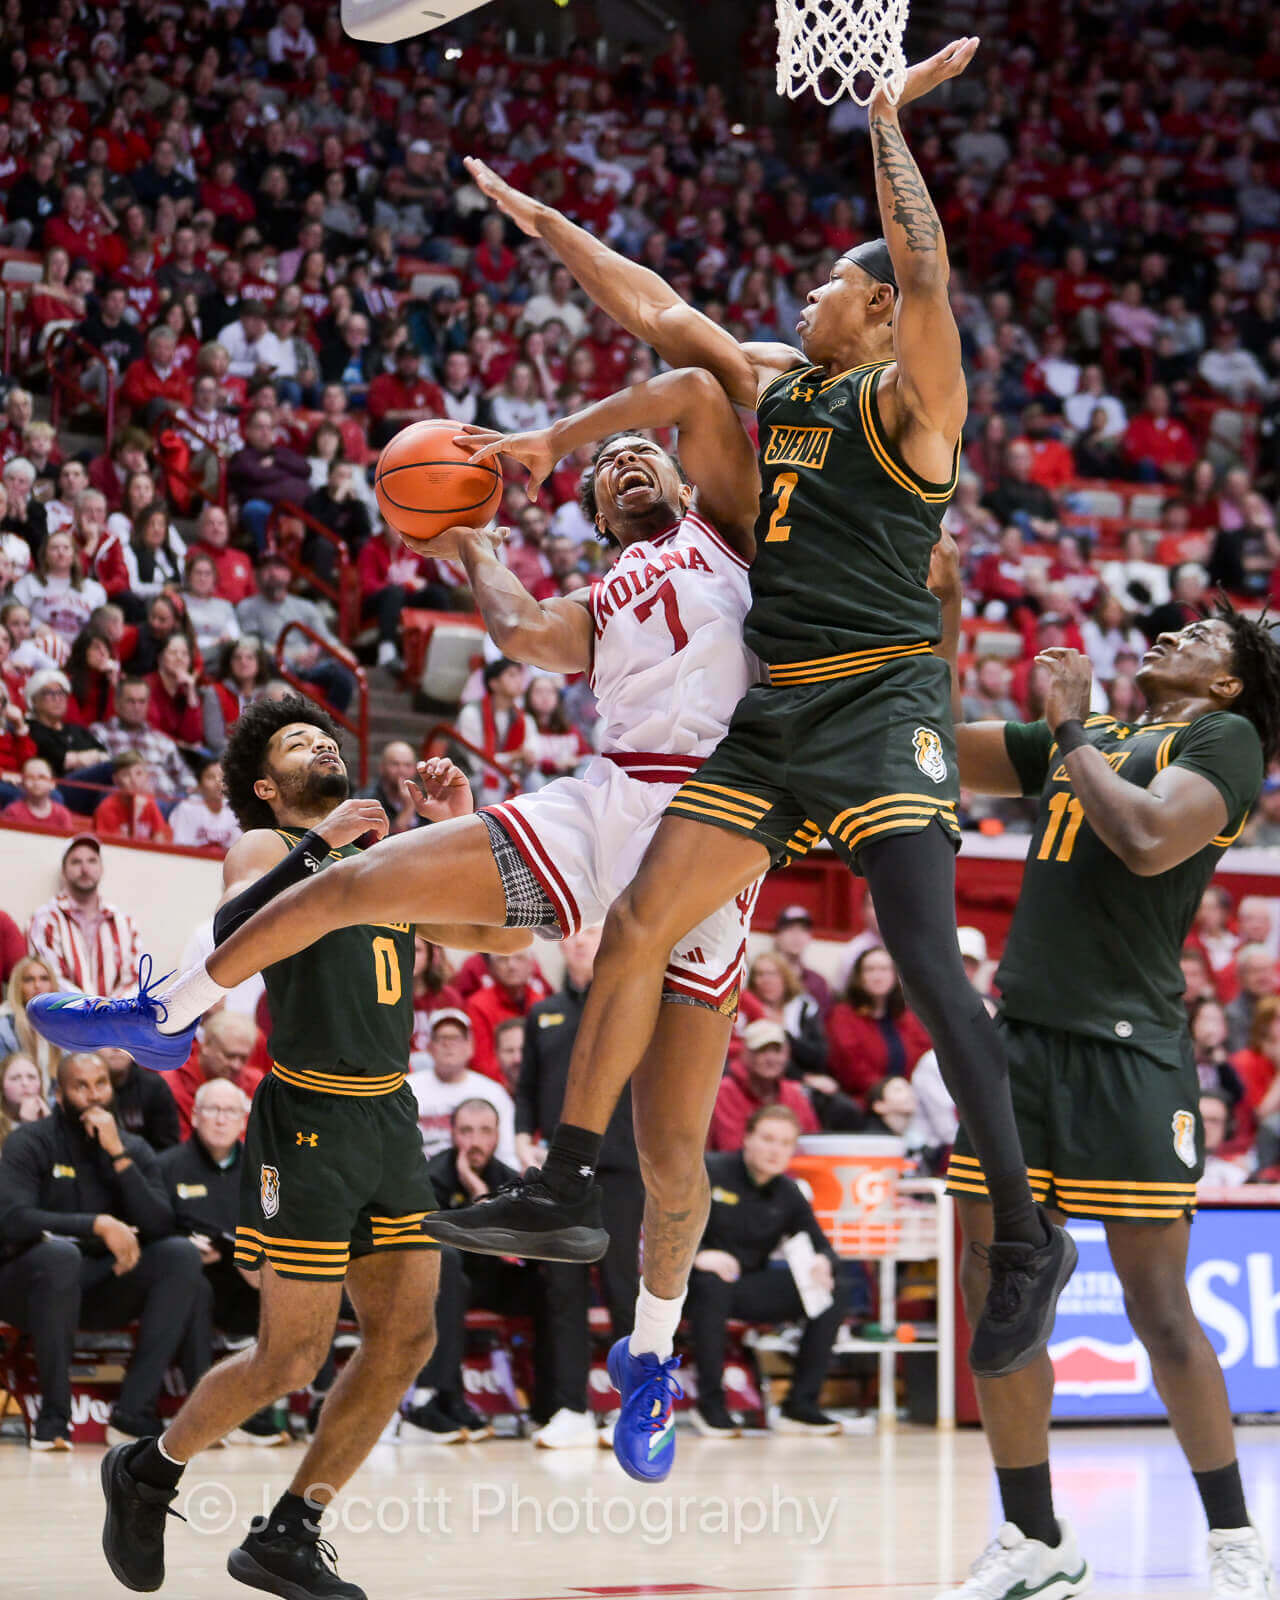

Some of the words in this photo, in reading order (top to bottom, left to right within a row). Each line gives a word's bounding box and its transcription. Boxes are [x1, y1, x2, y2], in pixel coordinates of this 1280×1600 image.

[766, 426, 831, 467] SIENA
[764, 472, 799, 542] 2
[594, 546, 714, 641] NDIANA
[633, 578, 689, 657] 7
[1036, 791, 1085, 862] 11
[372, 936, 402, 1006] 0
